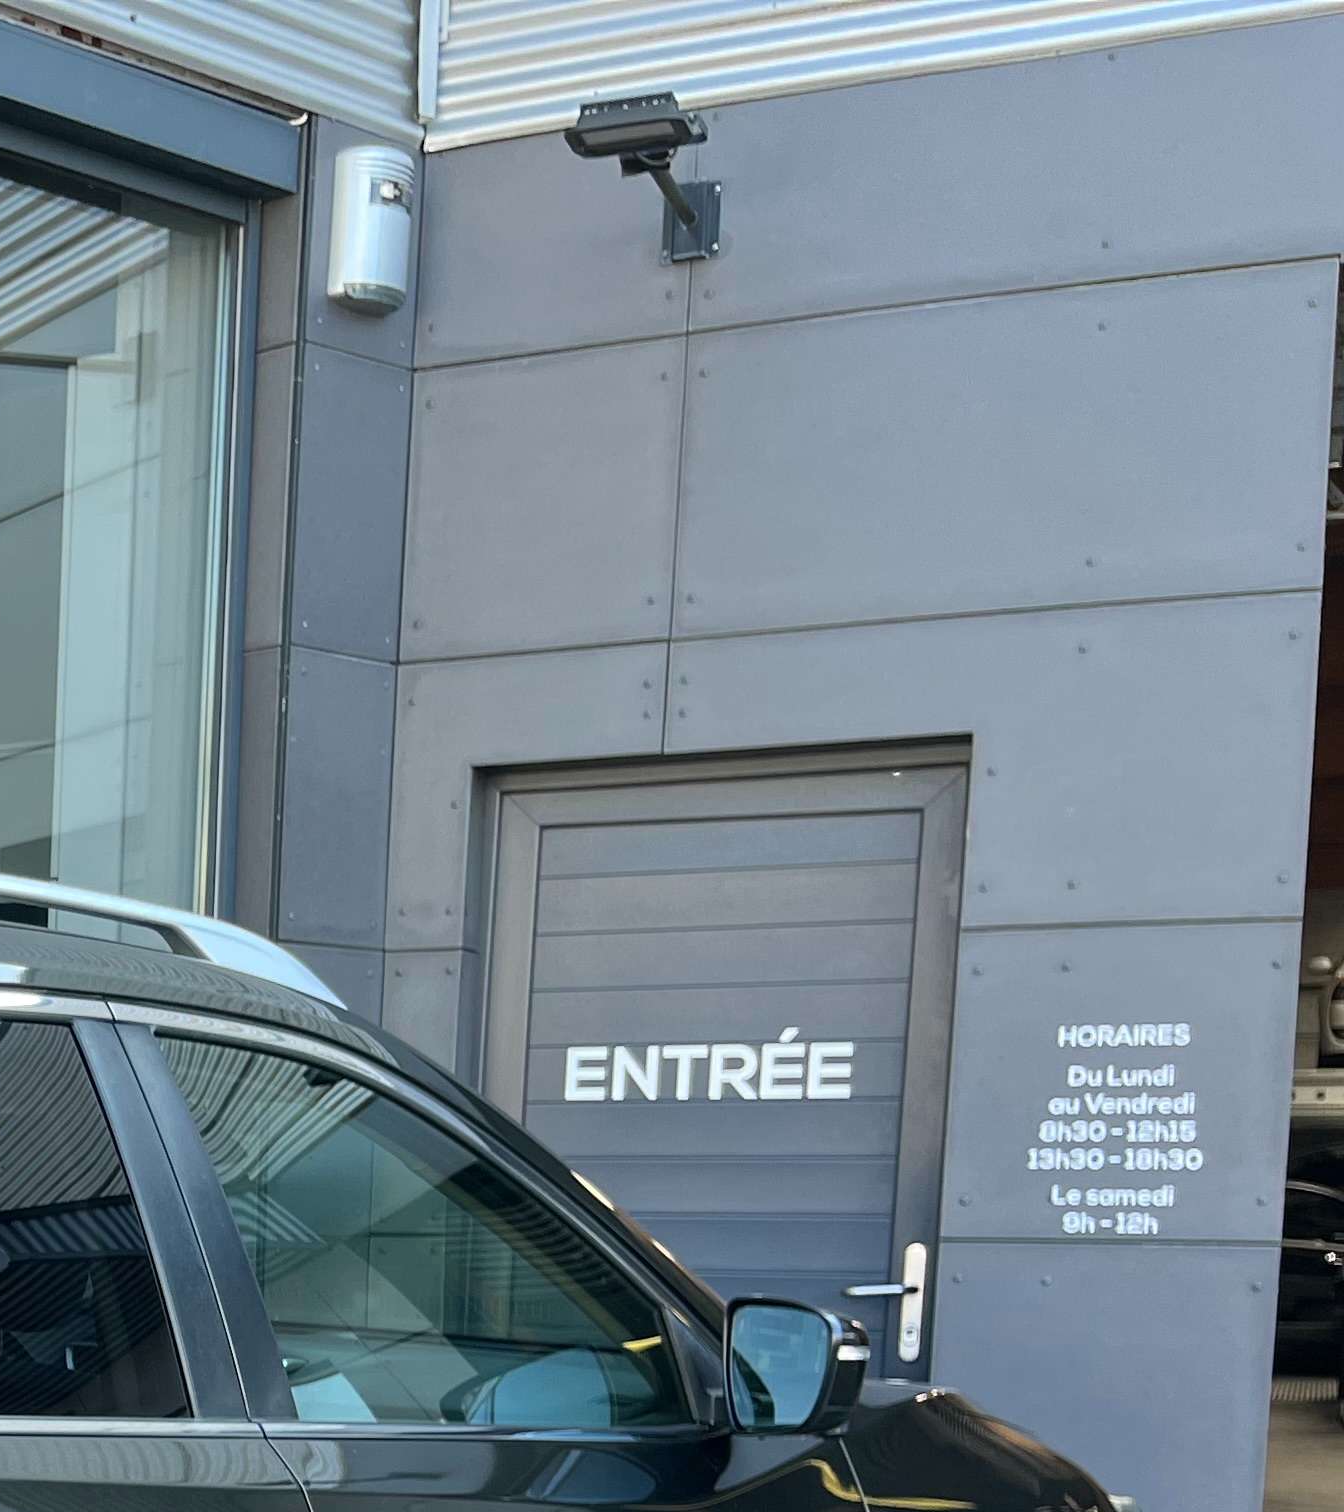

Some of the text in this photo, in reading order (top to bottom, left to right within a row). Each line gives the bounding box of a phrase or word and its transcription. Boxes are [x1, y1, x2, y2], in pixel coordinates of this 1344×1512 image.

[1057, 1023, 1191, 1048] HORAIRES
[564, 1026, 855, 1101] ENTRÉE
[1067, 1063, 1176, 1088] Du Lundi
[1047, 1091, 1197, 1116] au Vendredi
[1050, 1183, 1176, 1207] Le samedi
[1061, 1210, 1096, 1235] 9h
[1115, 1210, 1159, 1236] 12h
